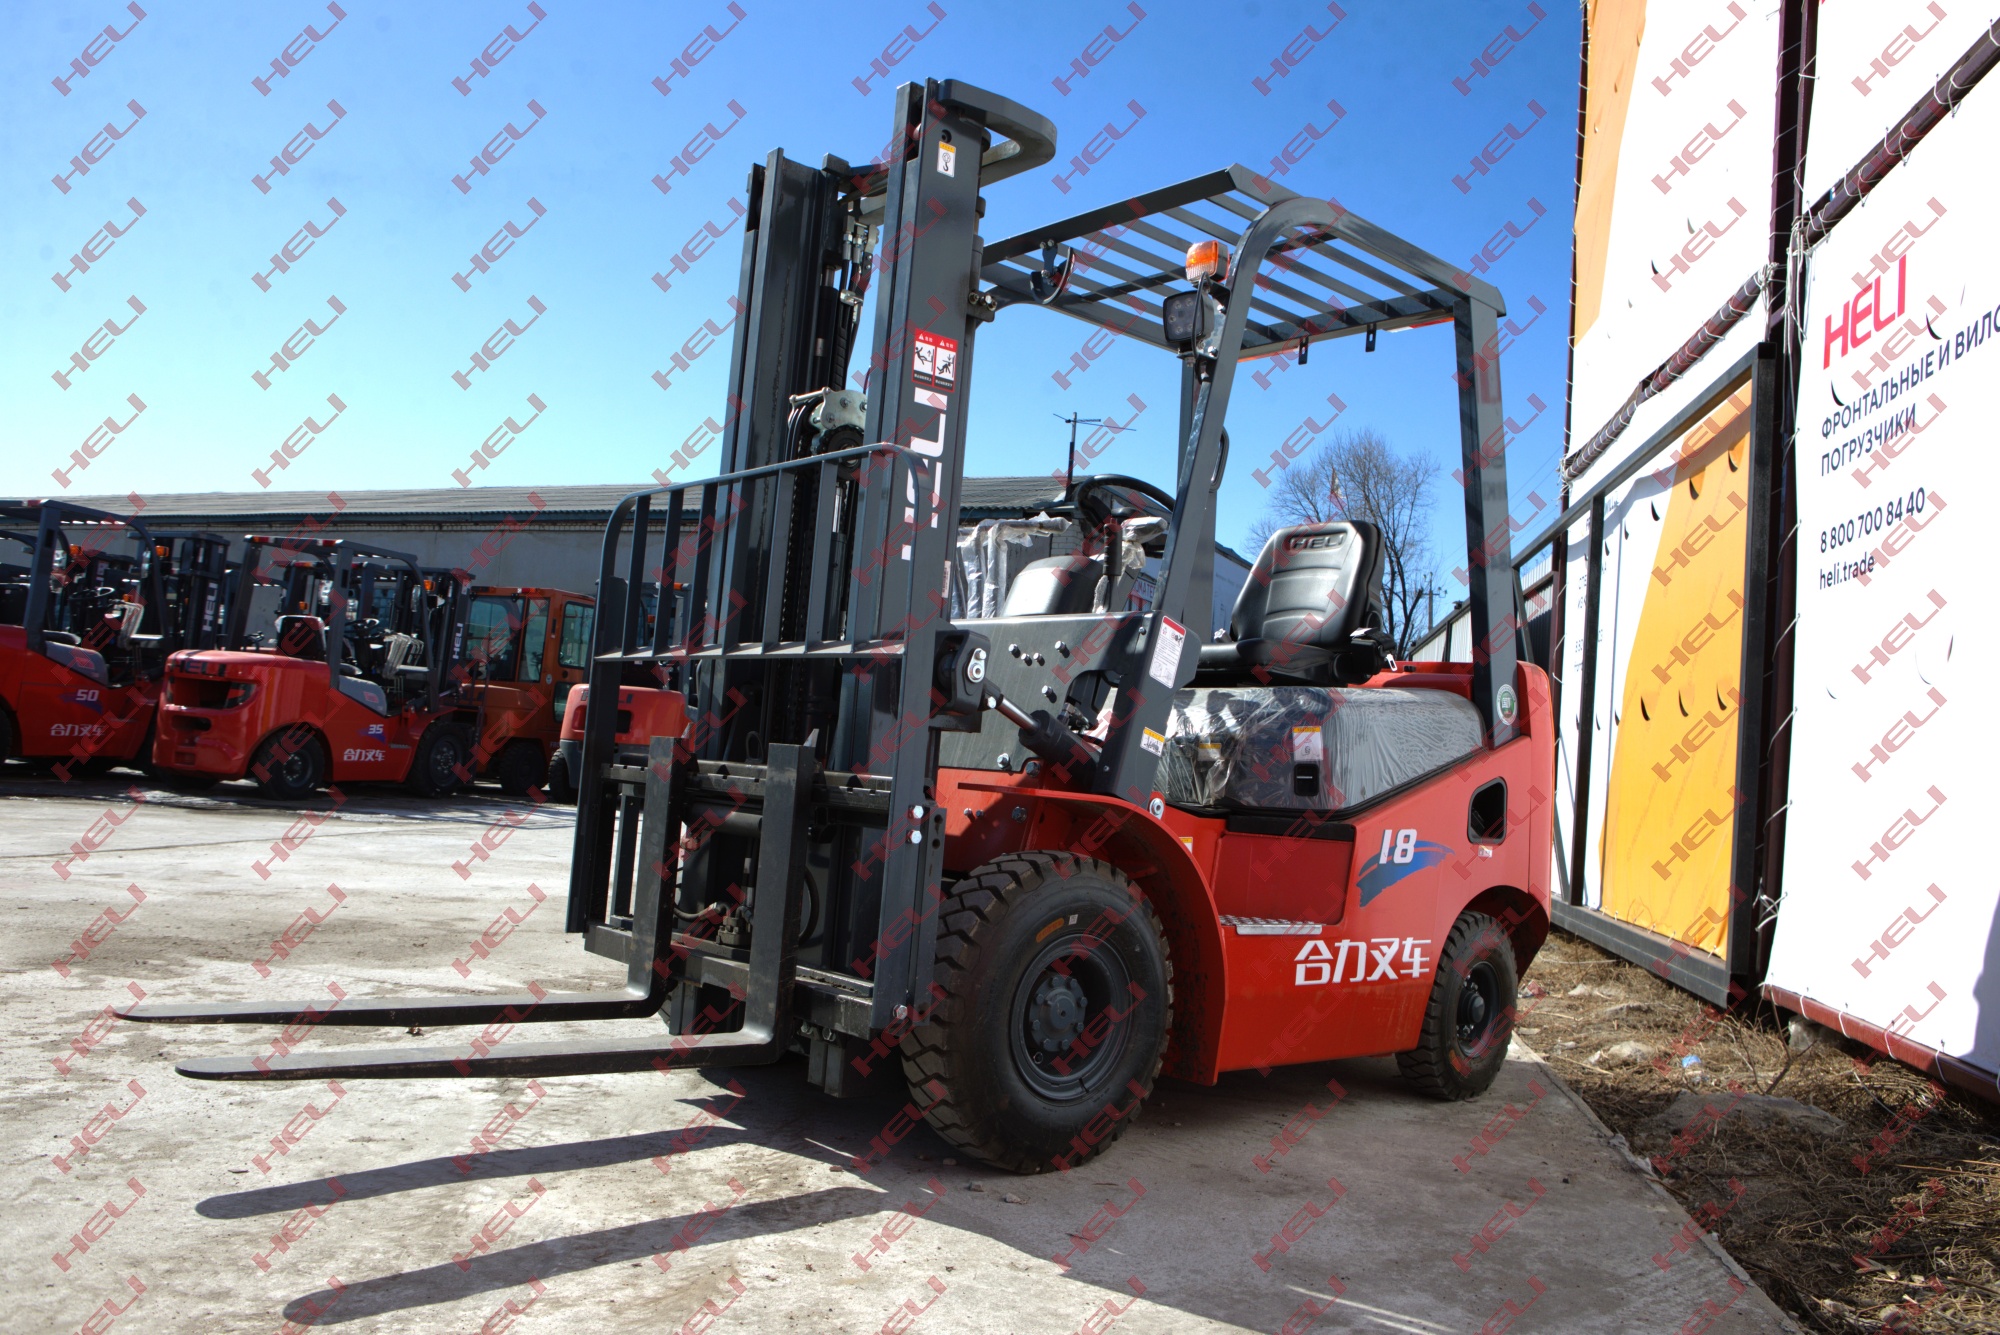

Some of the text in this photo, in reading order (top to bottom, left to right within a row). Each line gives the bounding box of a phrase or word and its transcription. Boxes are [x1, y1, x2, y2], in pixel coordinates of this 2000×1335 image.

[1823, 254, 1906, 370] HELI
[1821, 350, 1935, 439] ФРОНТАЛЬНЫЕ
[1939, 339, 1950, 370] И
[1821, 403, 1916, 476] ПОГРУЗЧИКИ
[1820, 487, 1925, 553] 8 800 700 84 40
[1289, 533, 1344, 550] HELI
[1820, 551, 1875, 590] heli.trade
[202, 582, 218, 632] HELI
[453, 622, 463, 660] HELI
[170, 659, 226, 677] HELI
[76, 689, 99, 702] 50
[50, 723, 105, 737] 合力叉车
[367, 724, 384, 735] 35
[343, 748, 386, 762] 合力叉车
[1378, 828, 1418, 865] 18
[1294, 937, 1432, 986] 合力叉车
